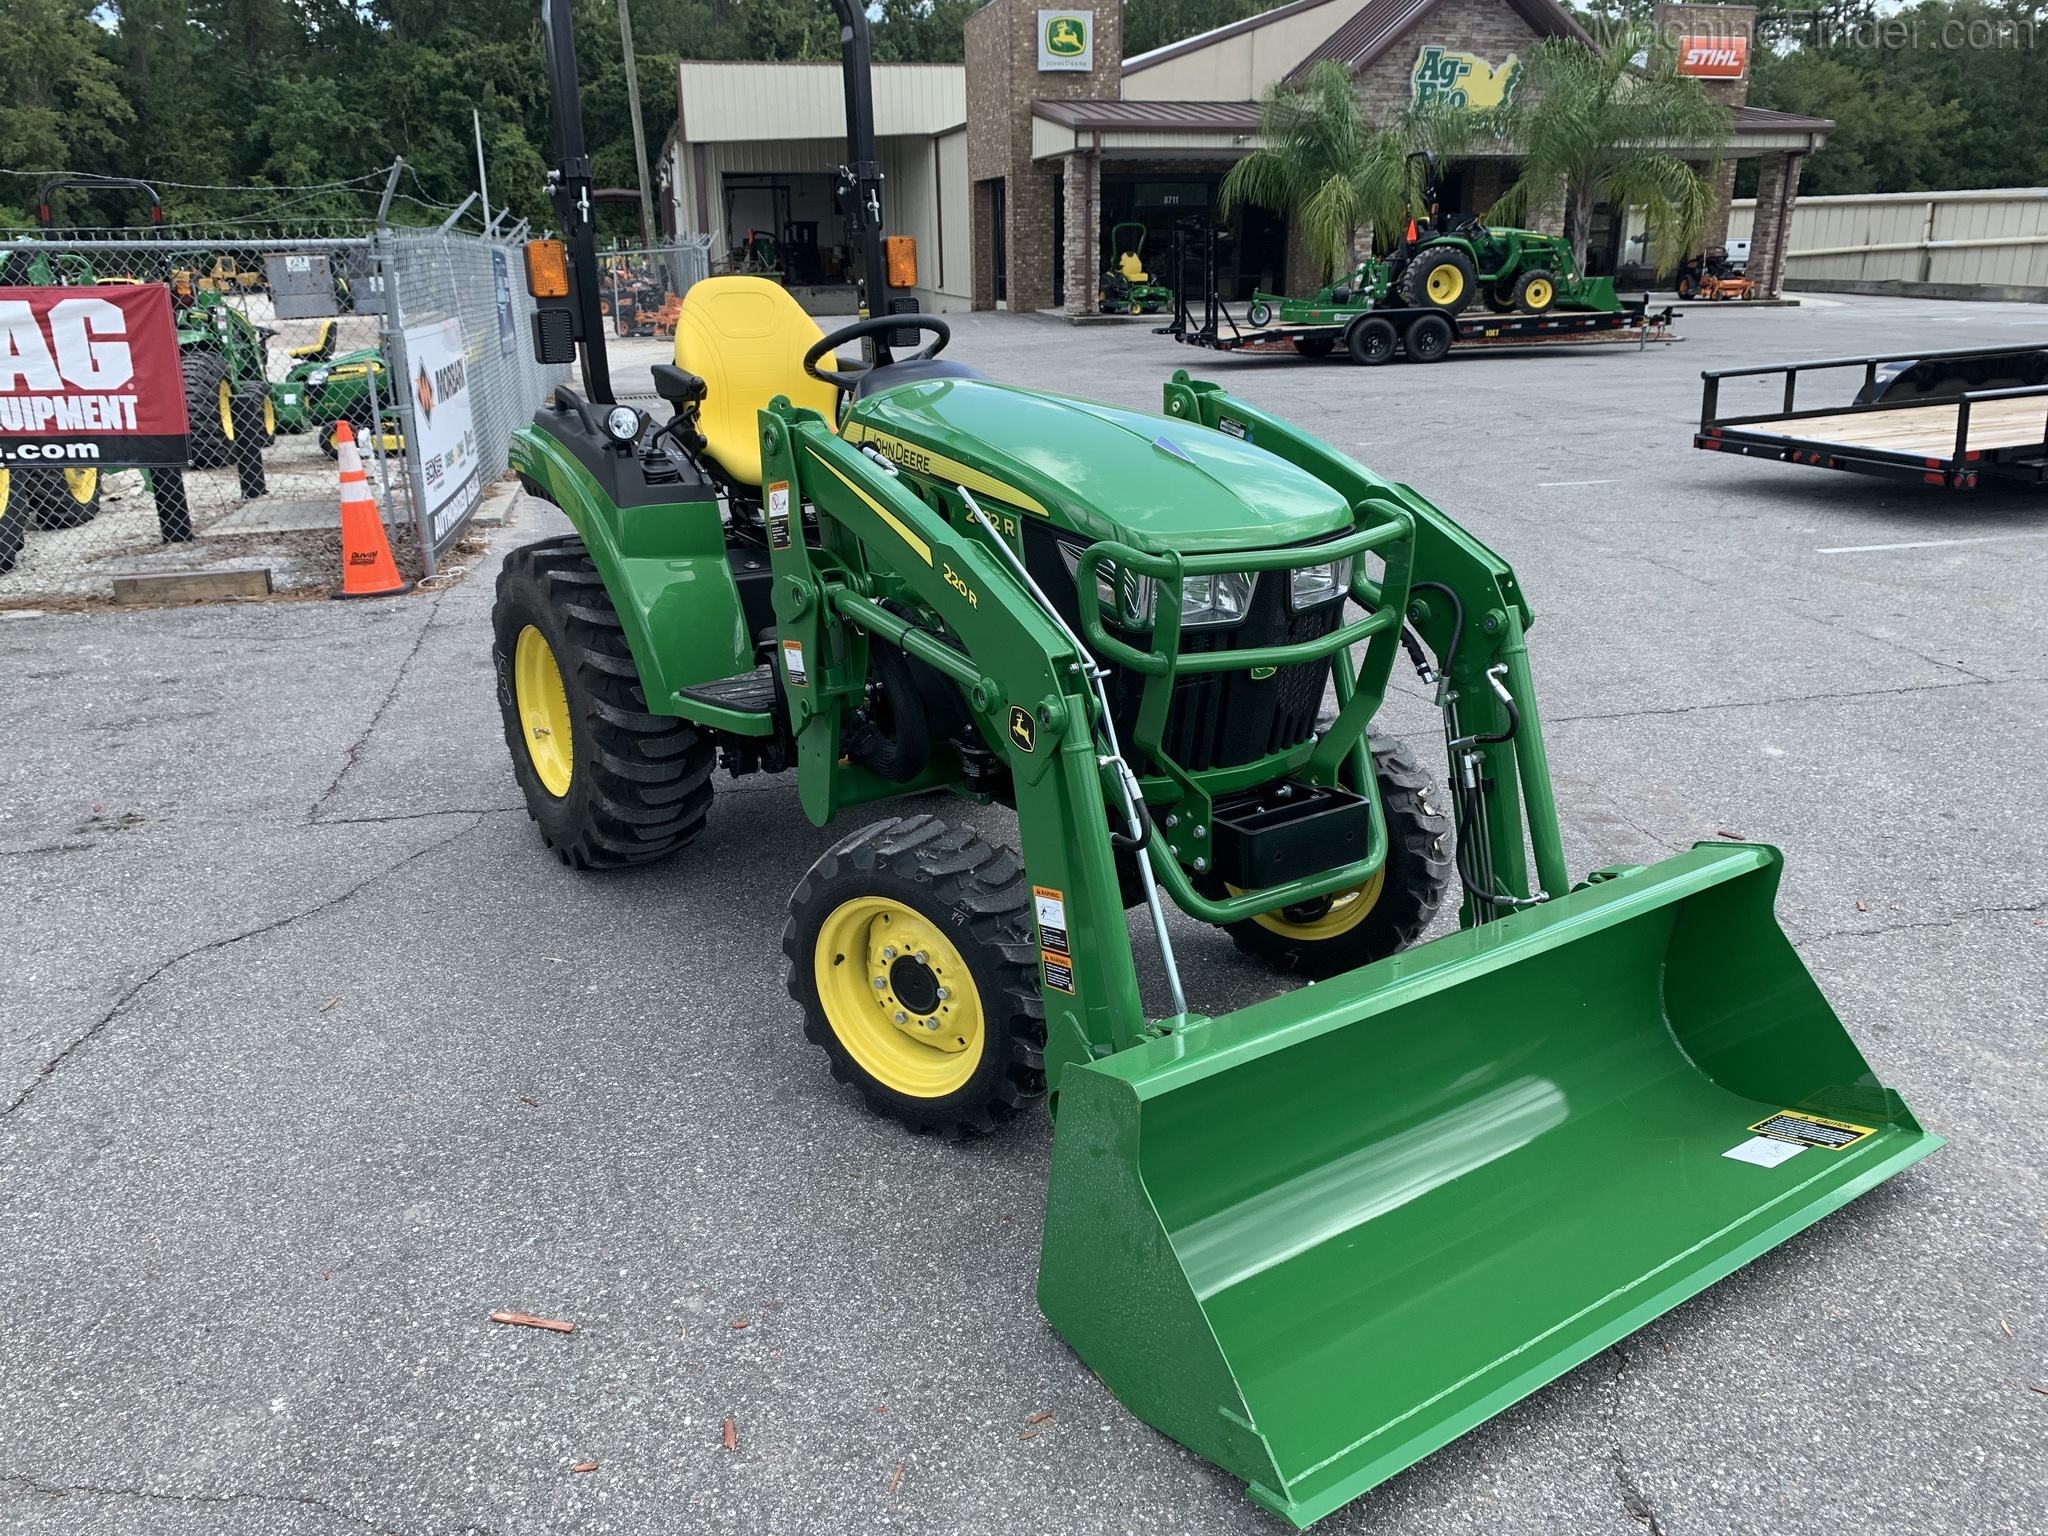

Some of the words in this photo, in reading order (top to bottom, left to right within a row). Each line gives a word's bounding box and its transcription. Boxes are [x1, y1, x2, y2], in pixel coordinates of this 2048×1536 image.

[1684, 49, 1740, 66] STIHL
[1417, 50, 1468, 88] Ag-
[1163, 195, 1179, 204] 8711
[0, 395, 138, 431] UIPMENT
[0, 443, 100, 459] .com
[895, 442, 931, 473] DEERE
[1815, 1118, 1854, 1129] CAUTION
